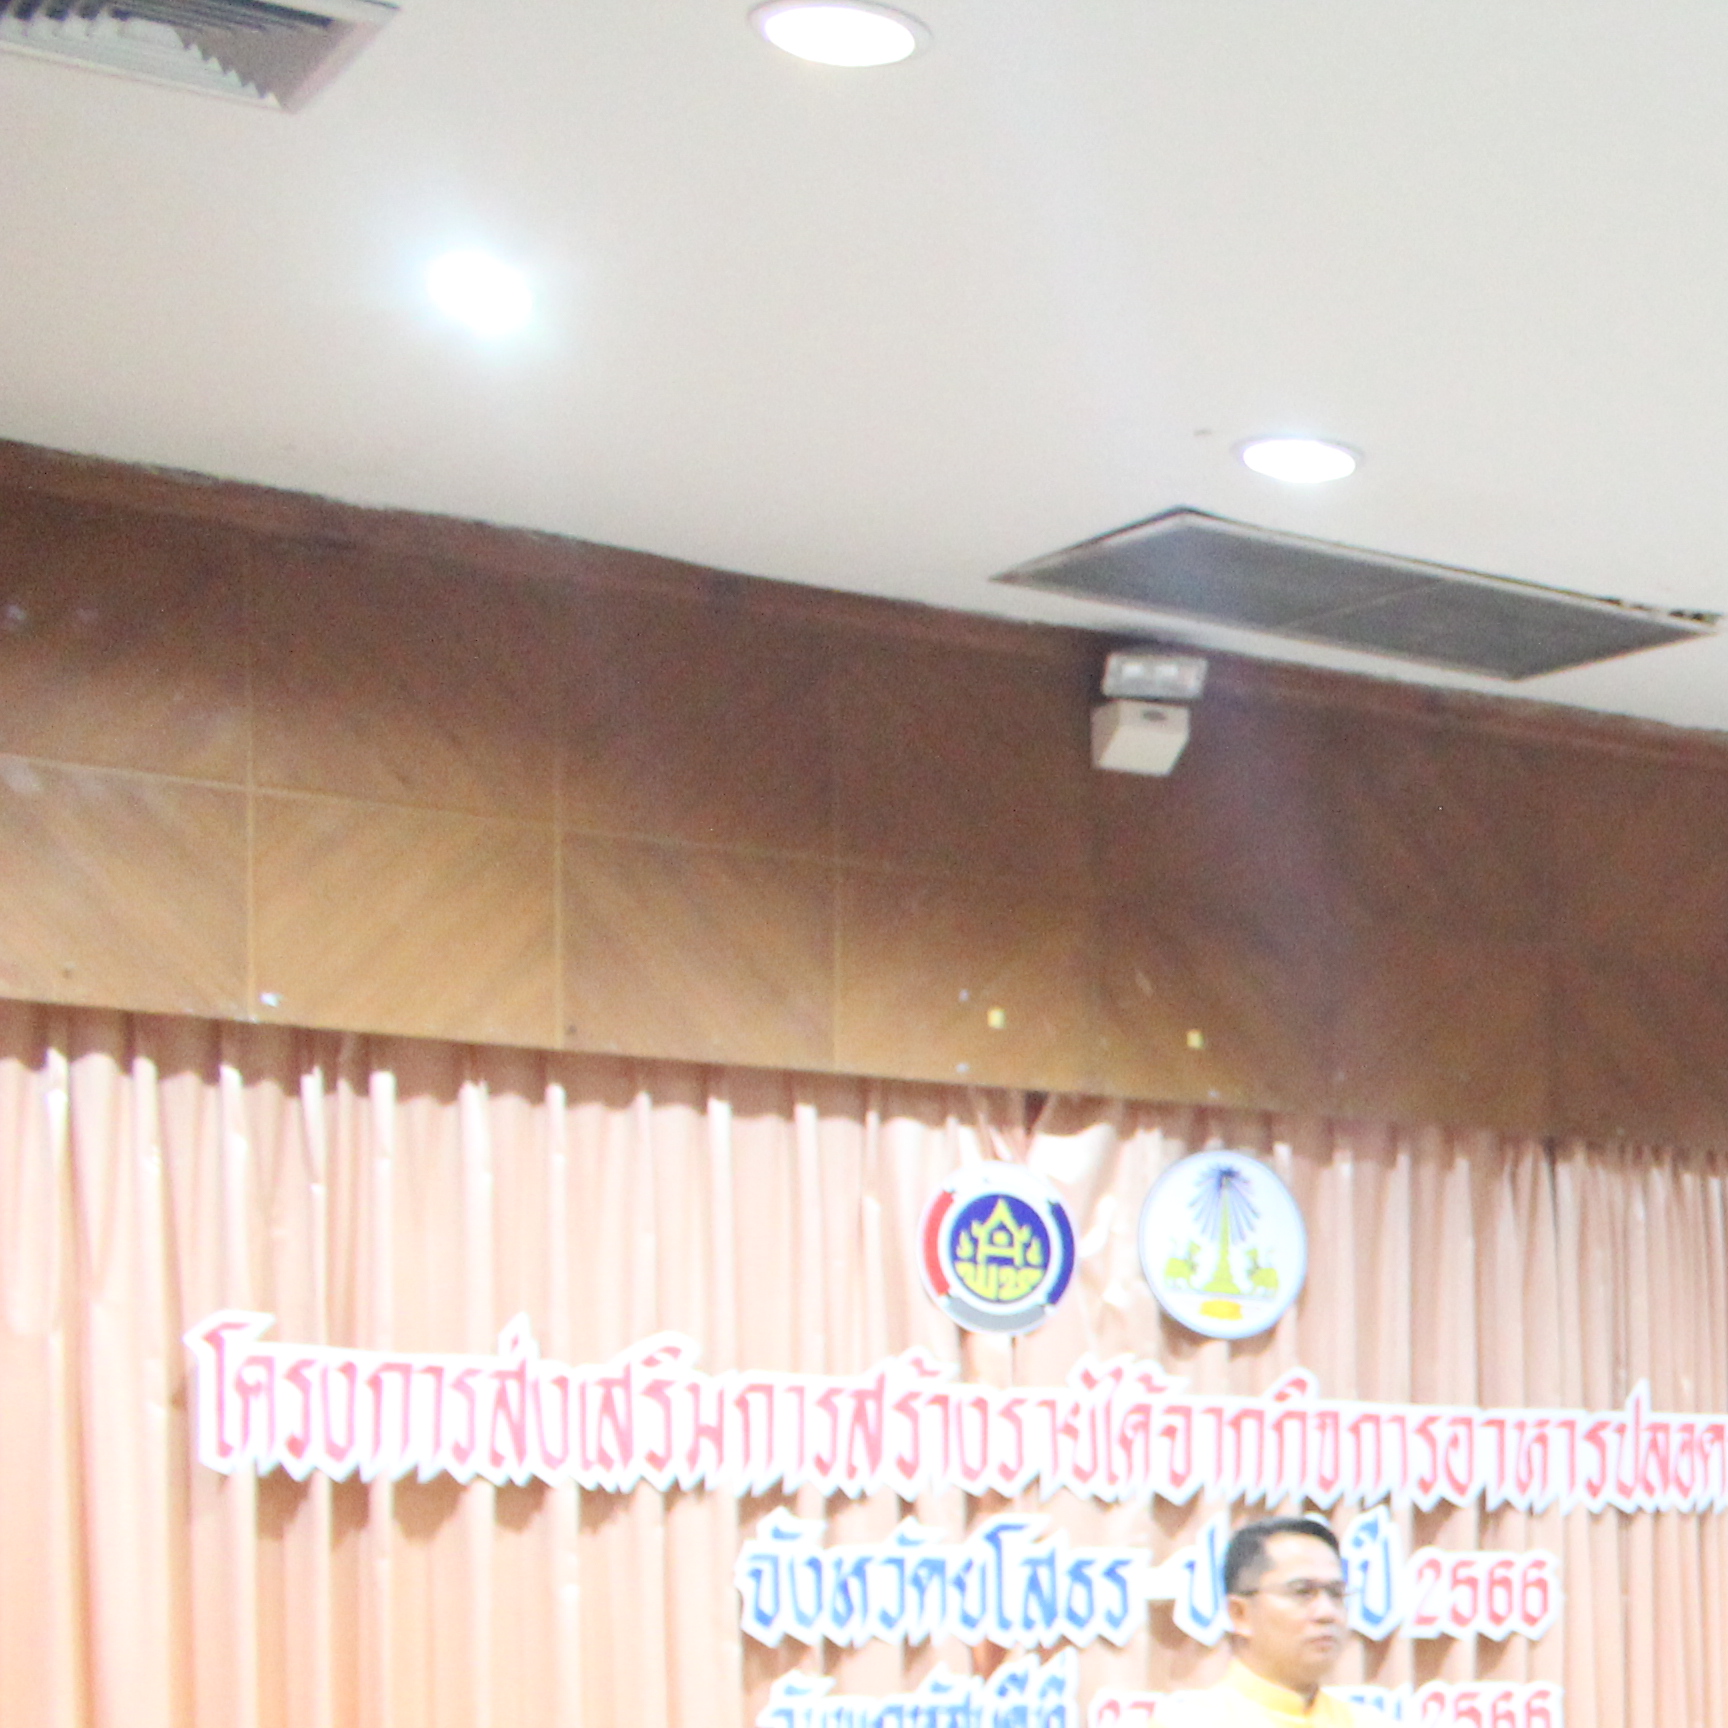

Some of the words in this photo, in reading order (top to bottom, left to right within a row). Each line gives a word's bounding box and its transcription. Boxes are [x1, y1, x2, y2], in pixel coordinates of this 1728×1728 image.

[746, 1520, 1135, 1632] จังหวัดยโสธร
[1412, 1556, 1551, 1628] 2566
